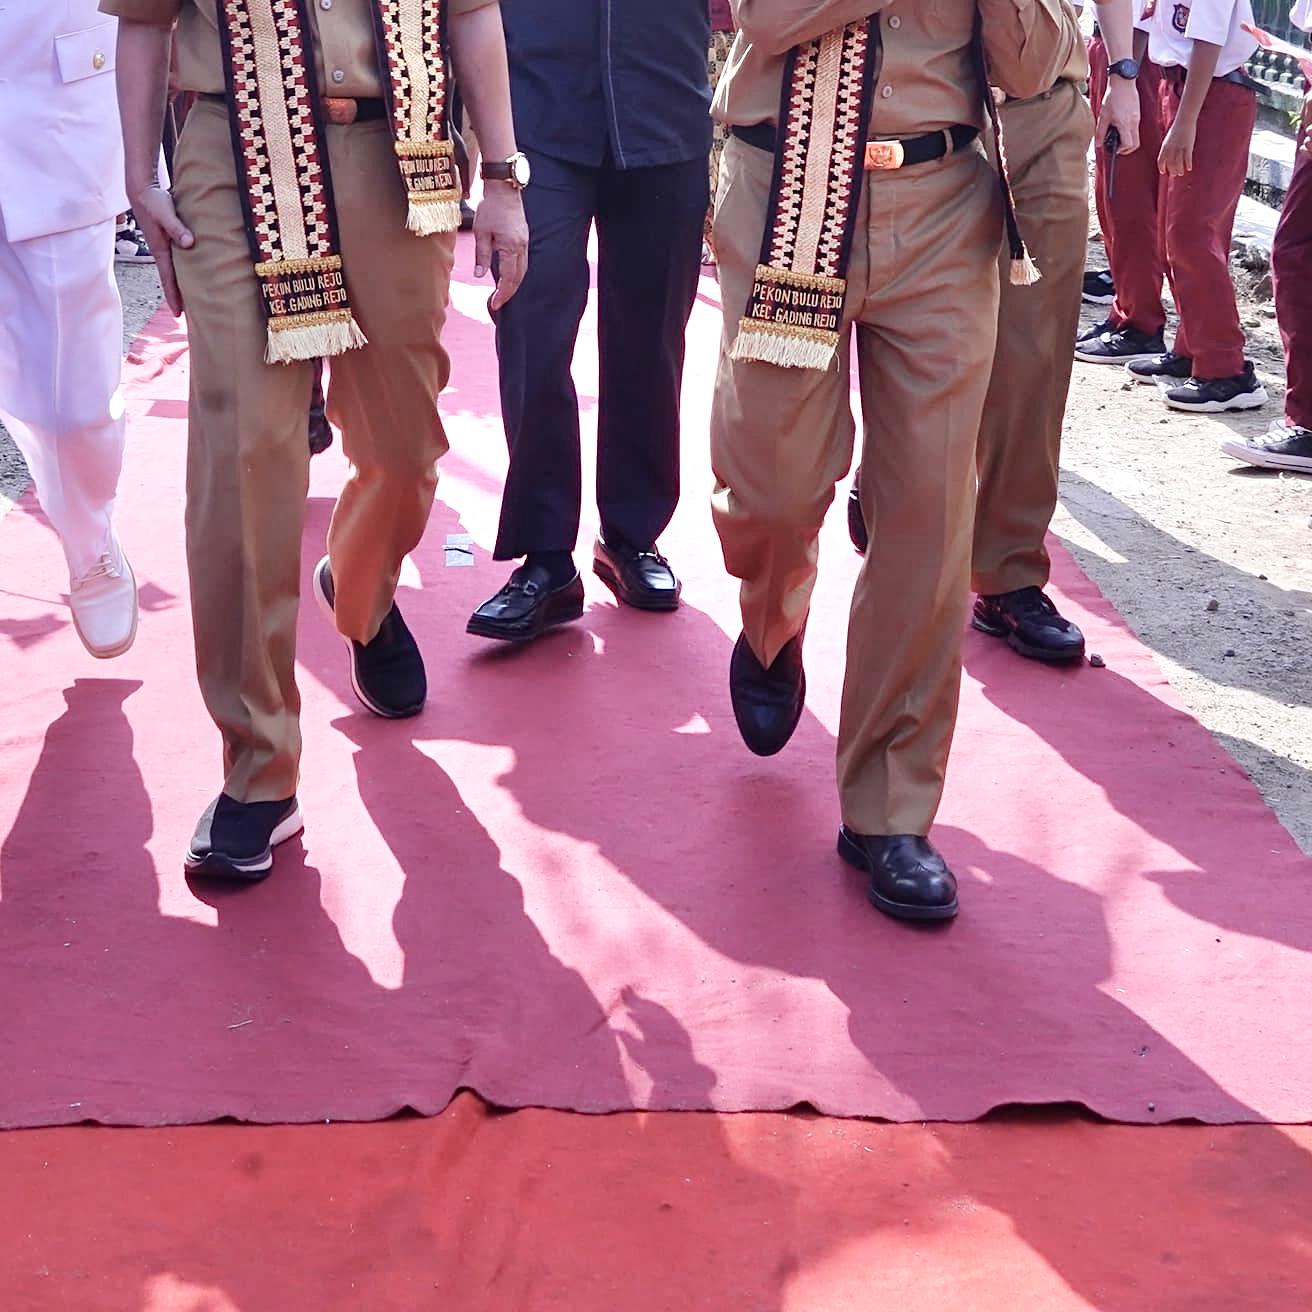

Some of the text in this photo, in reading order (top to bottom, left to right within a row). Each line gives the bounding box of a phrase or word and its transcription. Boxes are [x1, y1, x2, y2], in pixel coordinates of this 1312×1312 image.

[262, 271, 343, 298] PEKON BULU REJO
[323, 288, 348, 304] REJO
[752, 283, 843, 309] PEKON BULU REJO
[813, 313, 837, 328] REJO
